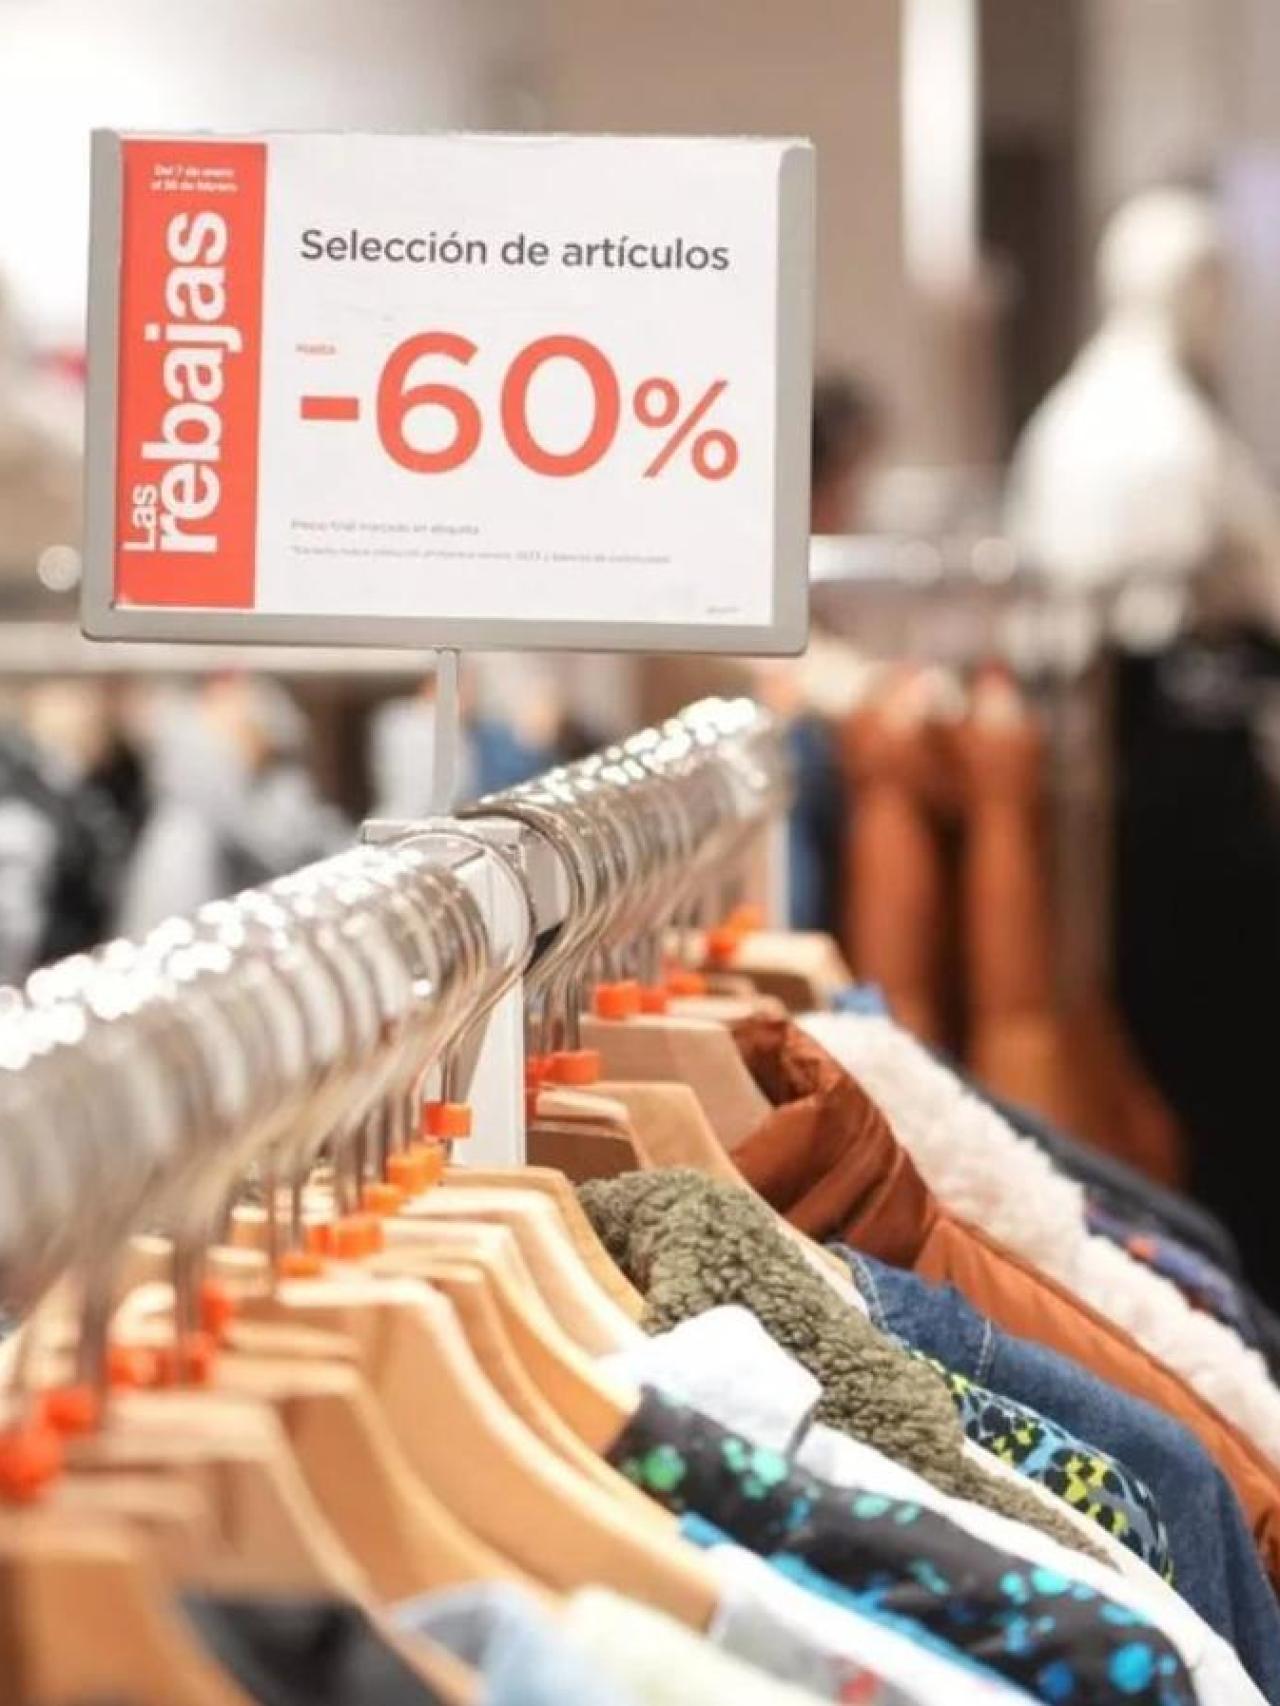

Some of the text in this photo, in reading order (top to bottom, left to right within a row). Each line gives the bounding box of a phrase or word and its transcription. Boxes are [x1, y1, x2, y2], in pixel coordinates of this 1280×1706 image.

[299, 228, 731, 271] Selección de artículos
[142, 211, 243, 554] rebajas
[123, 484, 157, 553] Las
